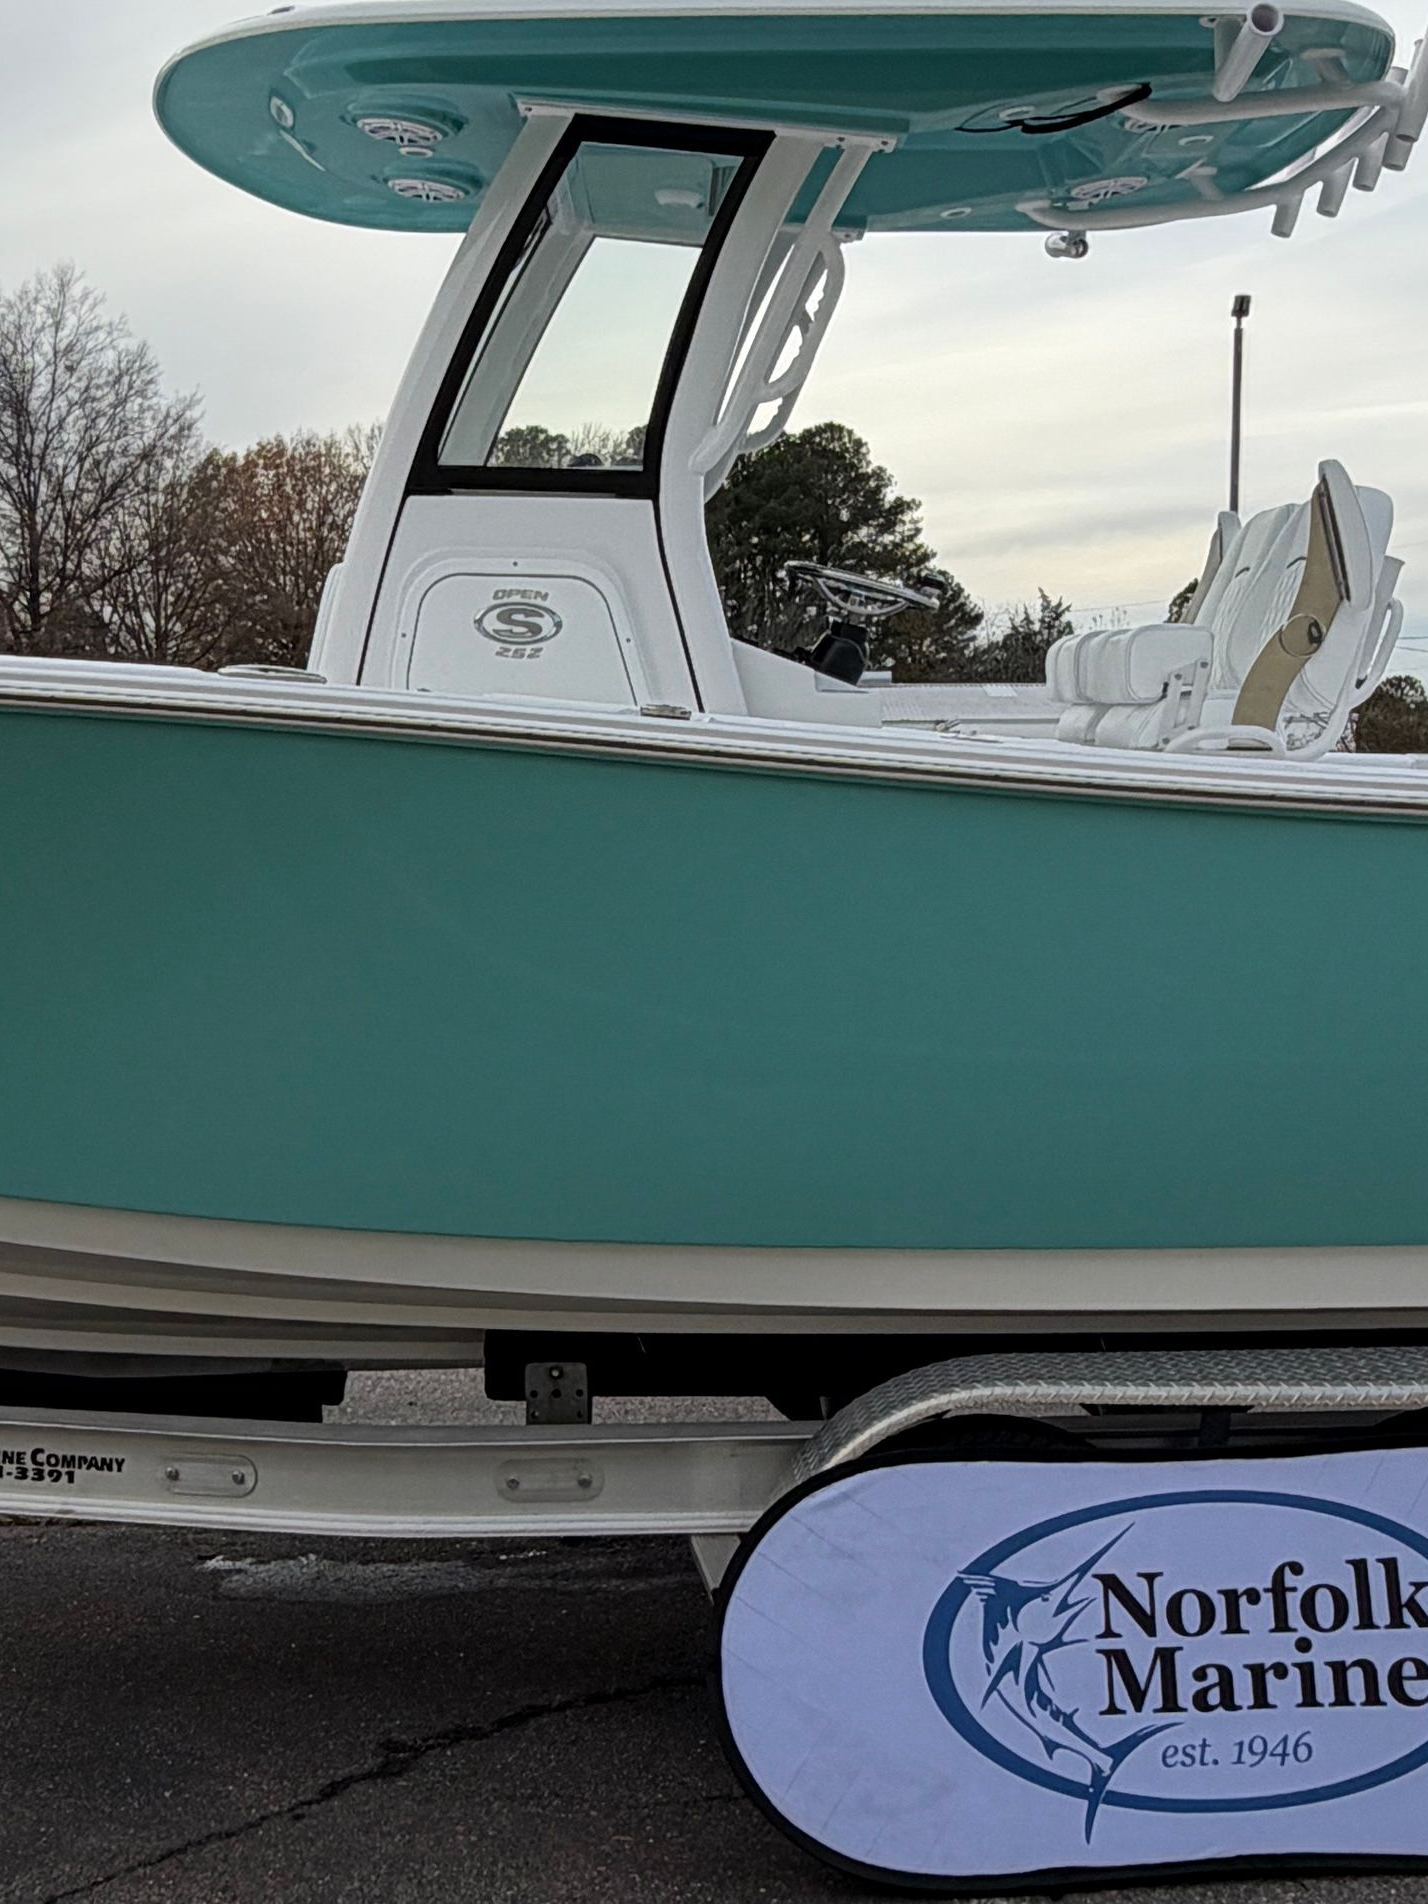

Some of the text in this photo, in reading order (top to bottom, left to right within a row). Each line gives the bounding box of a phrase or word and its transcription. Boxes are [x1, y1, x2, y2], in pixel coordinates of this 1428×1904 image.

[492, 588, 550, 602] OPEN
[30, 1448, 125, 1473] COMPANY
[1161, 1730, 1314, 1768] est. 1946
